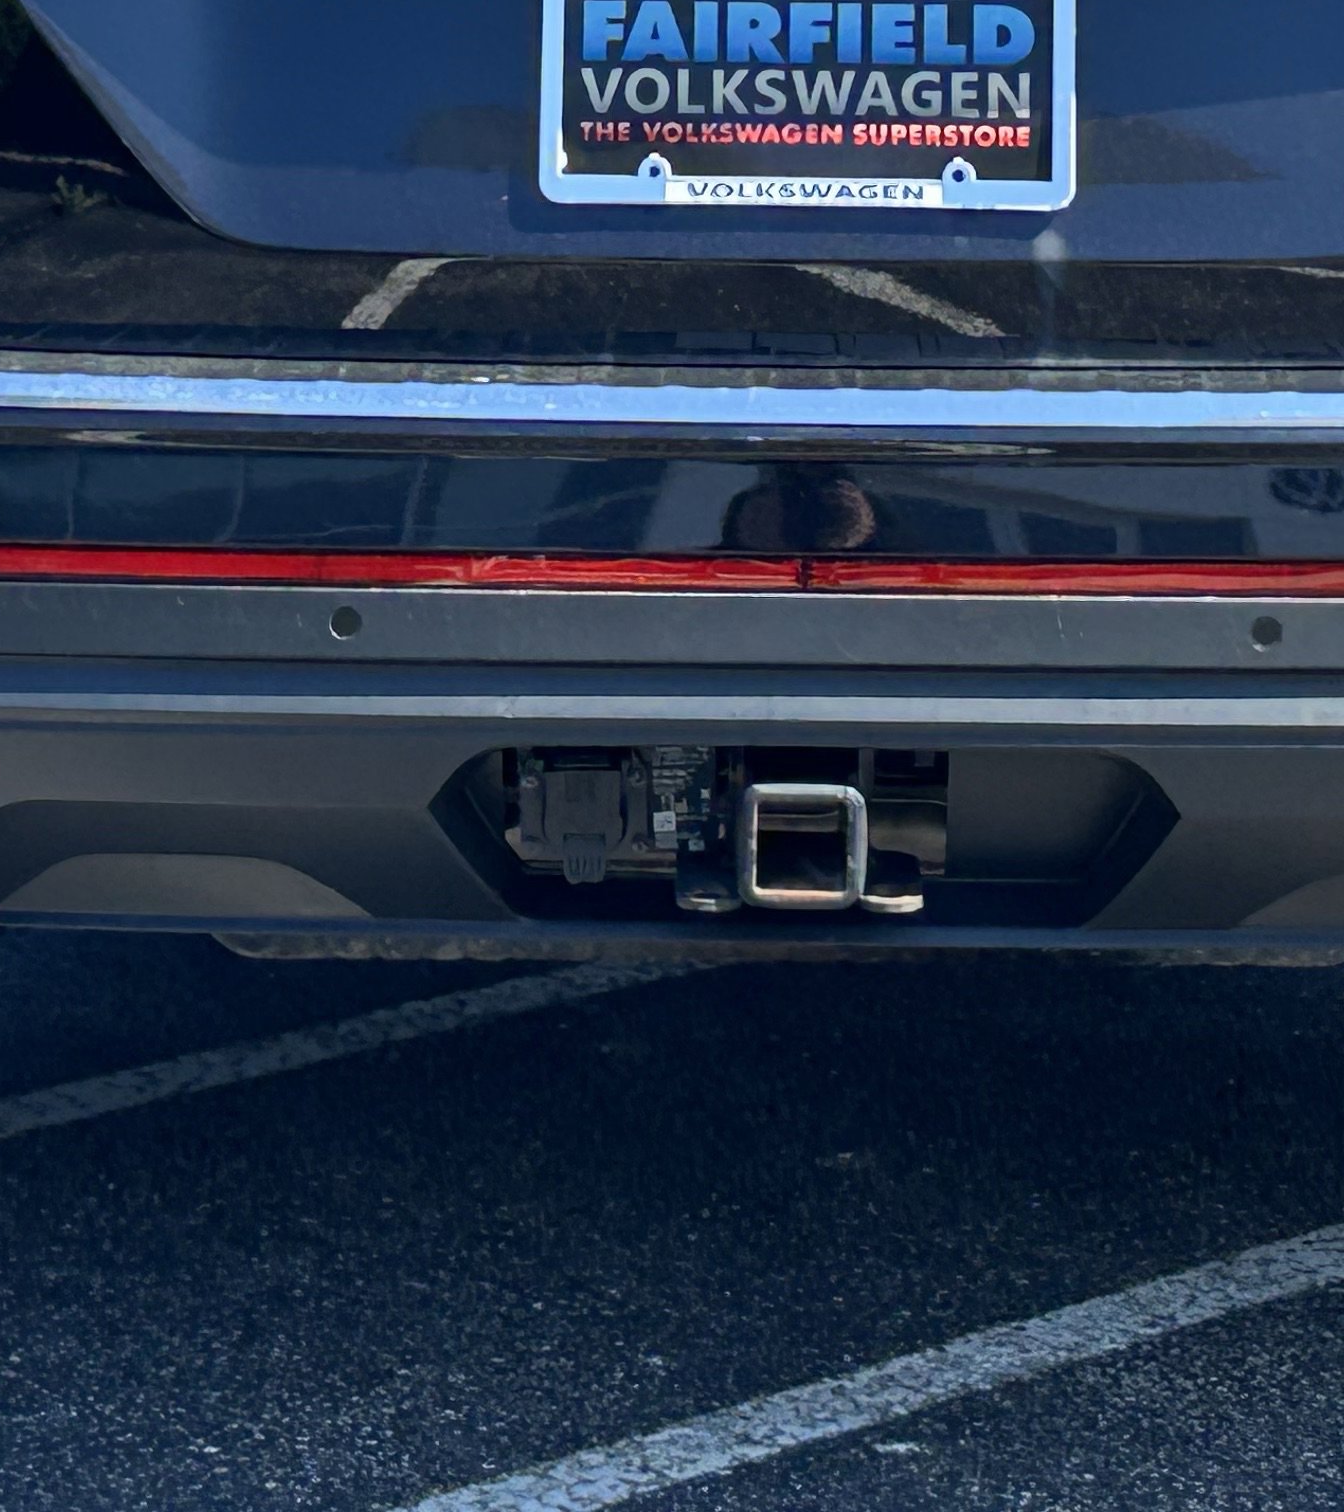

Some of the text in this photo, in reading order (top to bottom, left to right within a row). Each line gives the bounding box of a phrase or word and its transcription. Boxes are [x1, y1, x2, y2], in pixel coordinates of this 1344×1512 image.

[580, 66, 1032, 119] VOLKSWAGEN
[580, 121, 1032, 148] THE VOLKSWAGEN SUPERSTORE
[686, 182, 925, 200] VOLKSWAGEN
